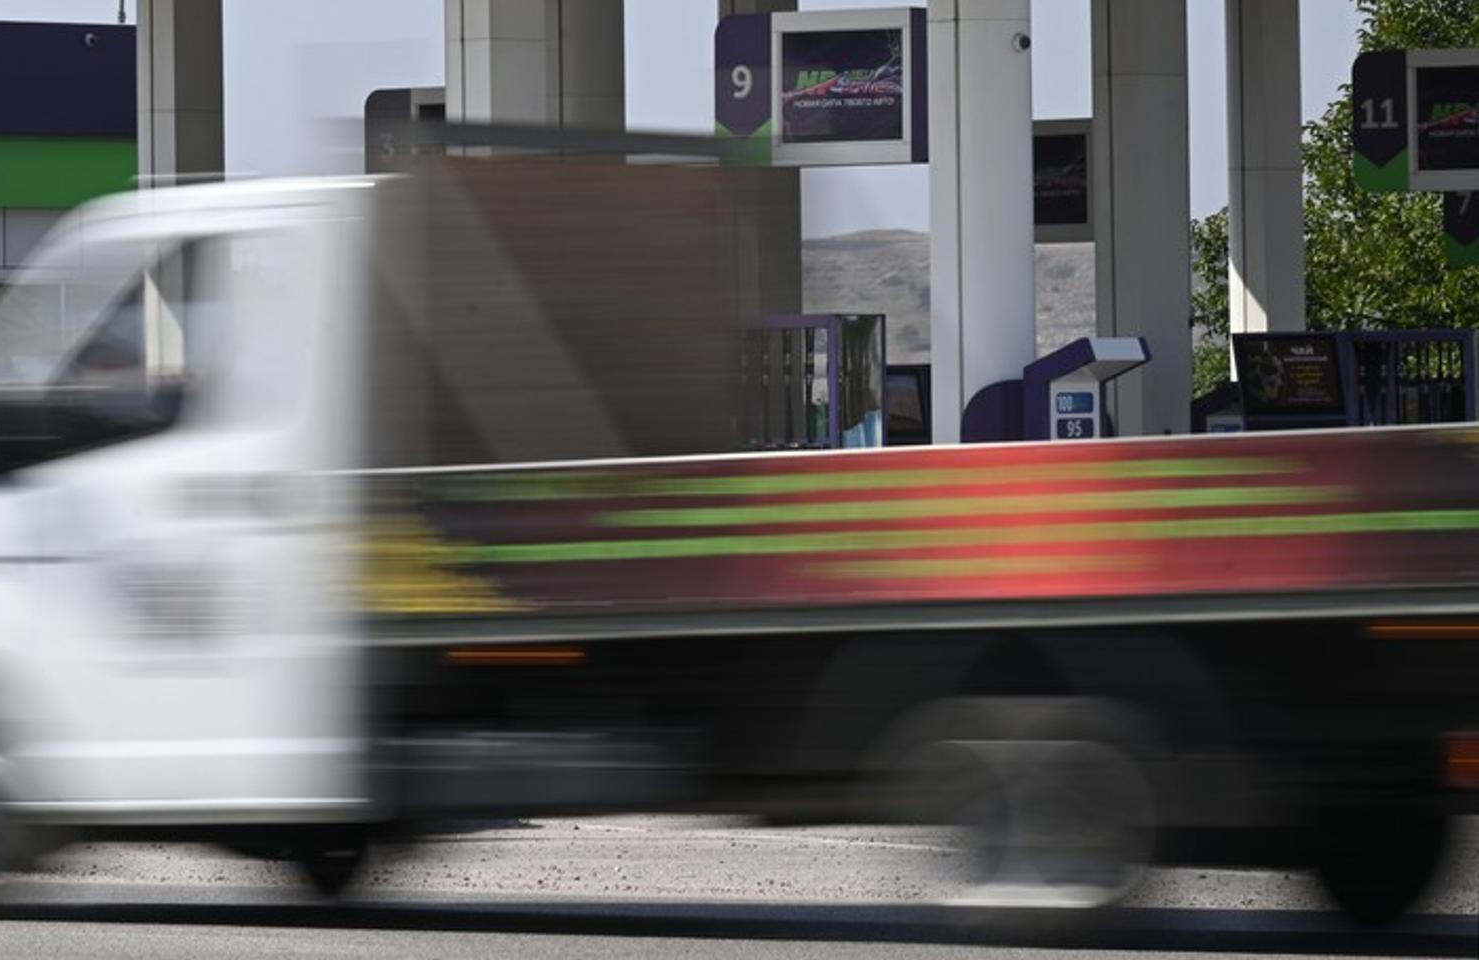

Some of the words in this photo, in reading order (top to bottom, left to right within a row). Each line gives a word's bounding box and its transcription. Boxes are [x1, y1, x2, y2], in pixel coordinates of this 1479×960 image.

[731, 65, 752, 98] 9
[1360, 98, 1398, 129] 11
[1066, 420, 1082, 438] 95
